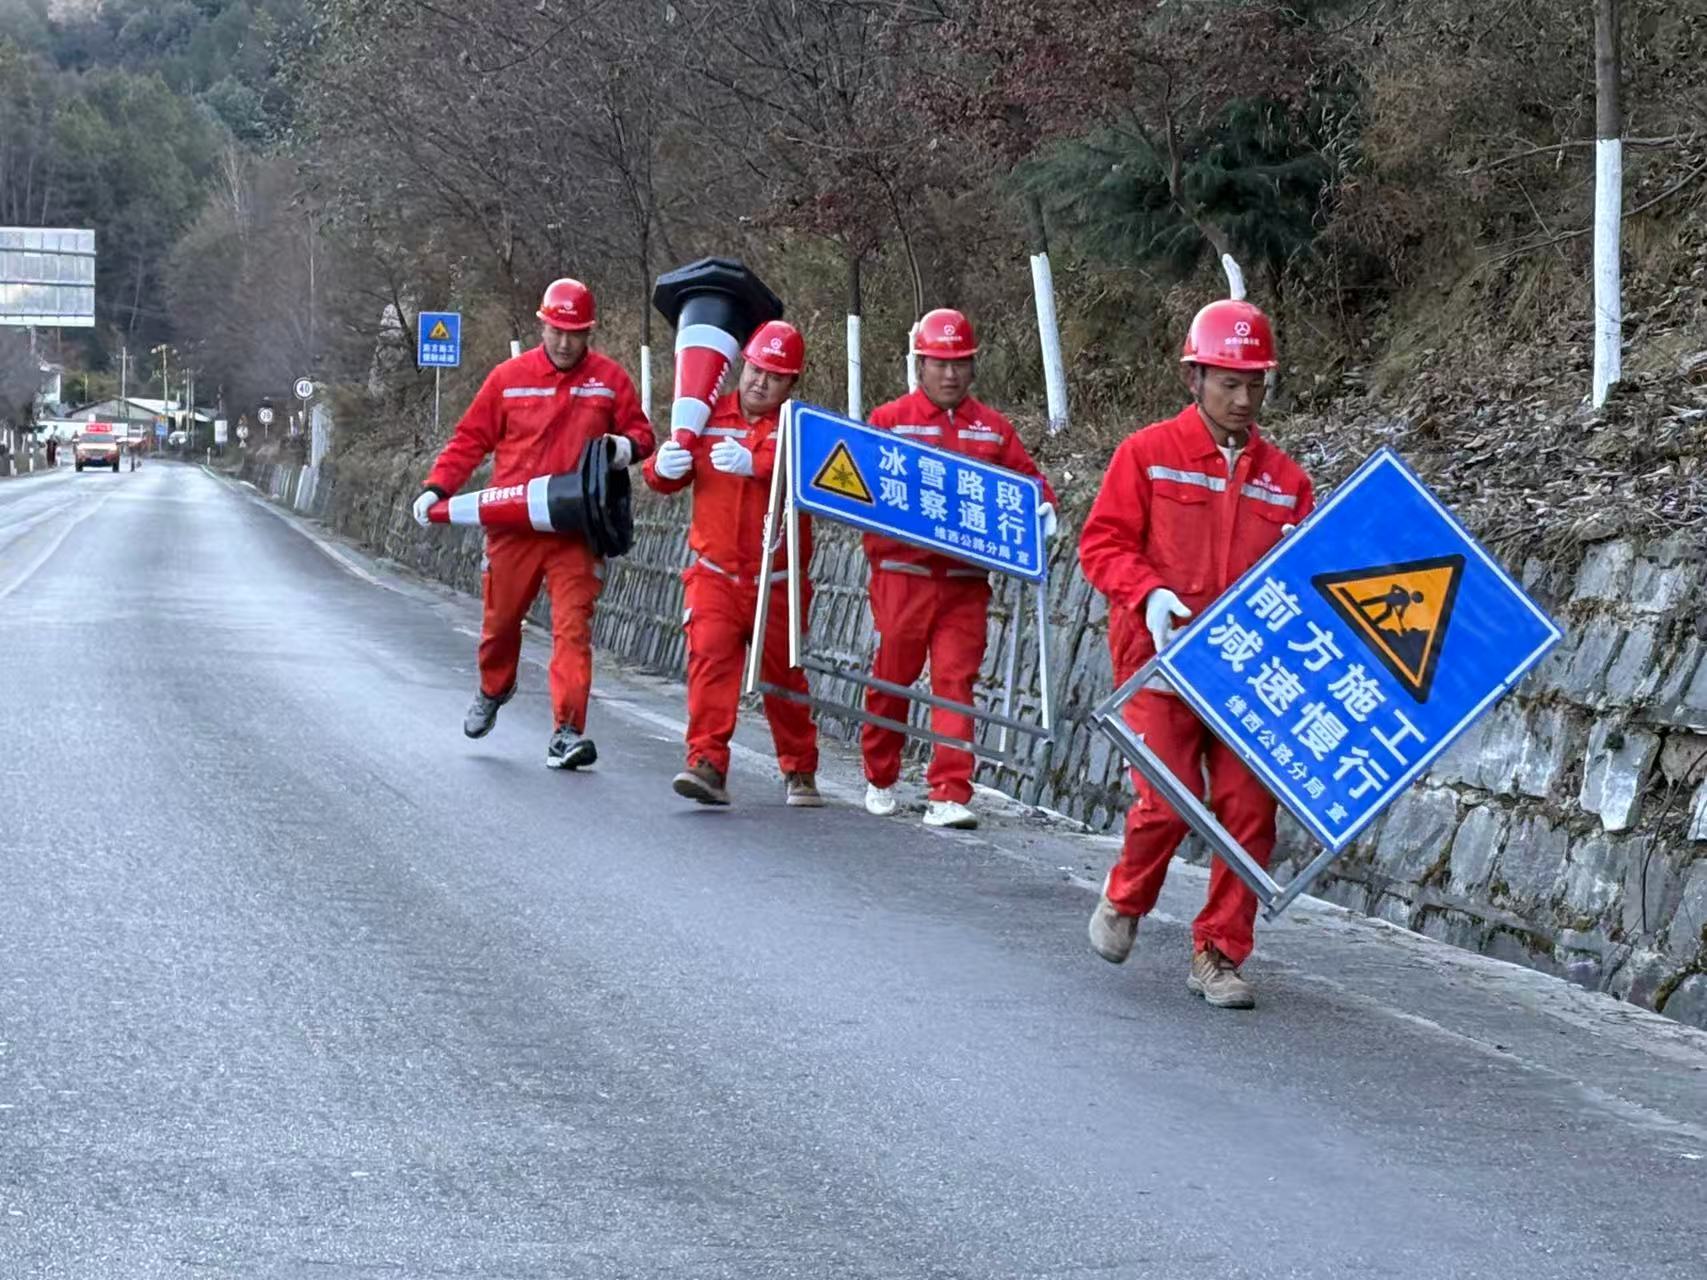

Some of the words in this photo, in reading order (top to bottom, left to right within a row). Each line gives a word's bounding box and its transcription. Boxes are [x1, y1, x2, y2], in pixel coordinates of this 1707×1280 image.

[299, 382, 310, 394] 40
[879, 446, 1024, 515] 冰雪路段
[879, 476, 1026, 544] 观察通行
[934, 525, 1011, 560] 维西公路分局
[1245, 576, 1427, 766] 前方施工
[1207, 613, 1390, 800] 减速慢行
[1224, 694, 1326, 800] 维西公路分局
[1325, 801, 1349, 825] 宣
